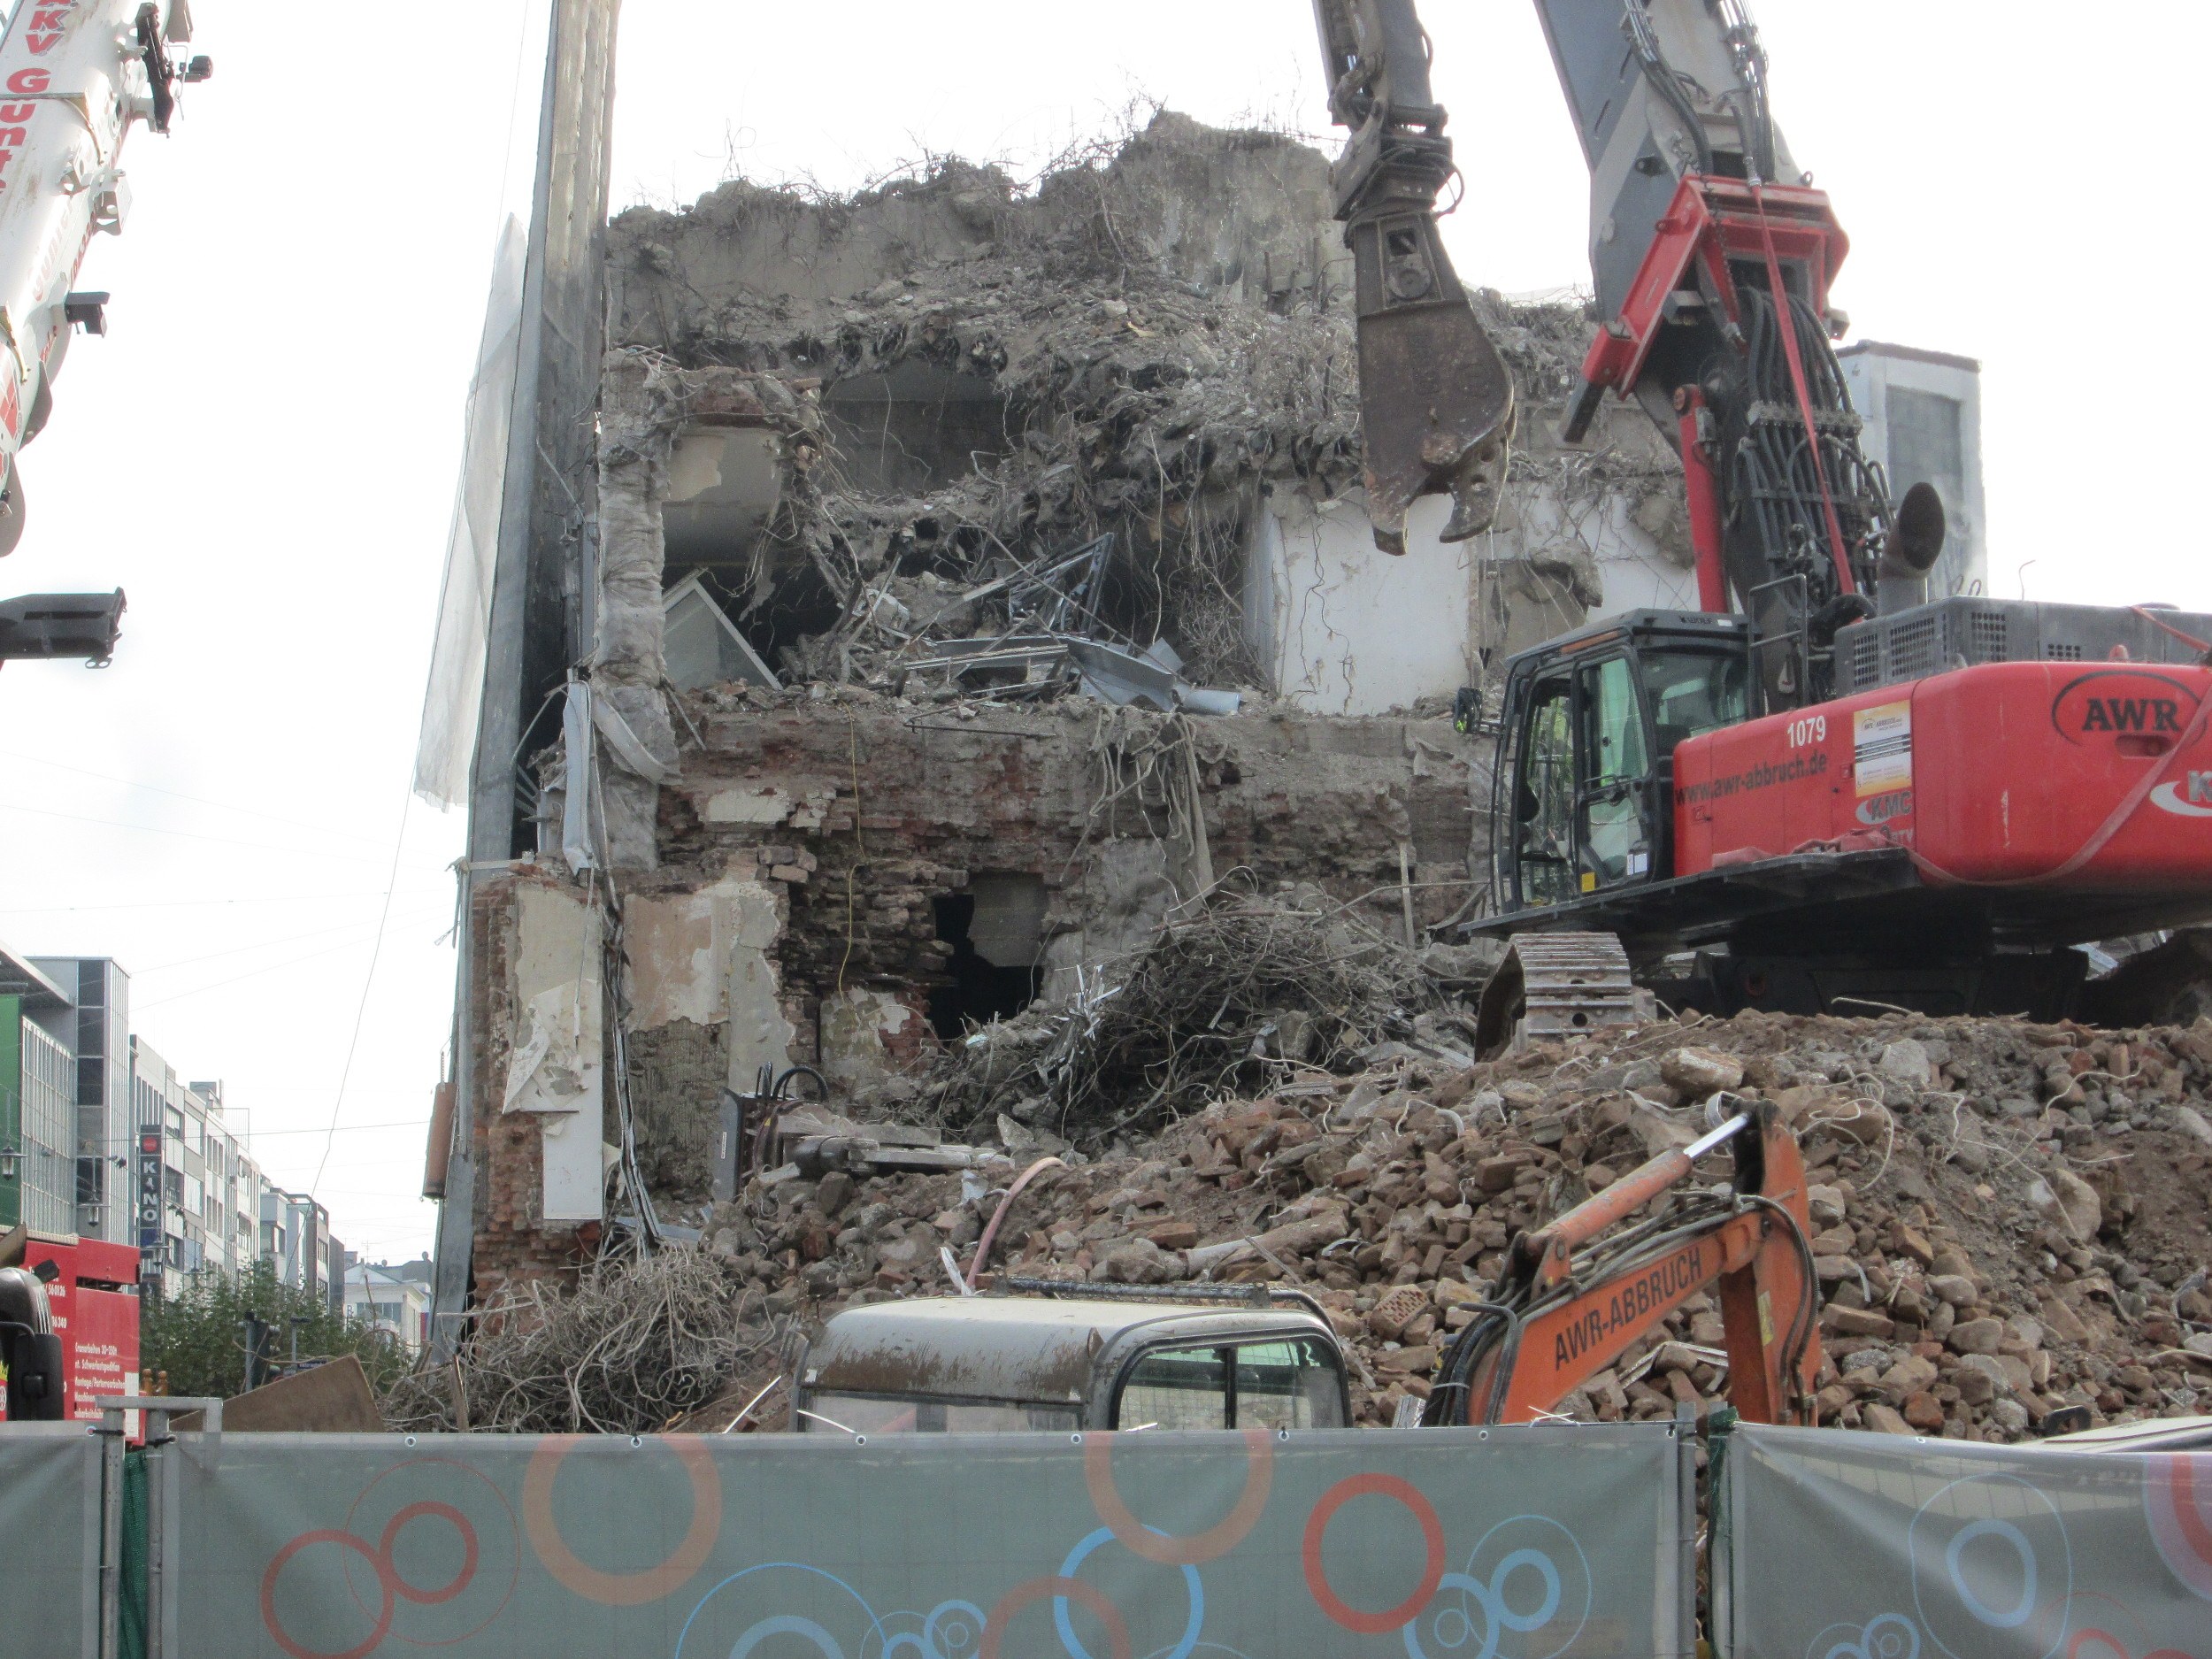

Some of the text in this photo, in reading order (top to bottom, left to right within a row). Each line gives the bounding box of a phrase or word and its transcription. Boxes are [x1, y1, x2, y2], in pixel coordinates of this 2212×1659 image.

[1786, 715, 1826, 749] 1079
[2082, 698, 2181, 732] AWR
[1675, 749, 1827, 806] www.awr-abbruch.de
[1870, 790, 1912, 821] KMC
[142, 1161, 158, 1222] KINO
[1555, 1246, 1702, 1371] AWR-ABBRUCH
